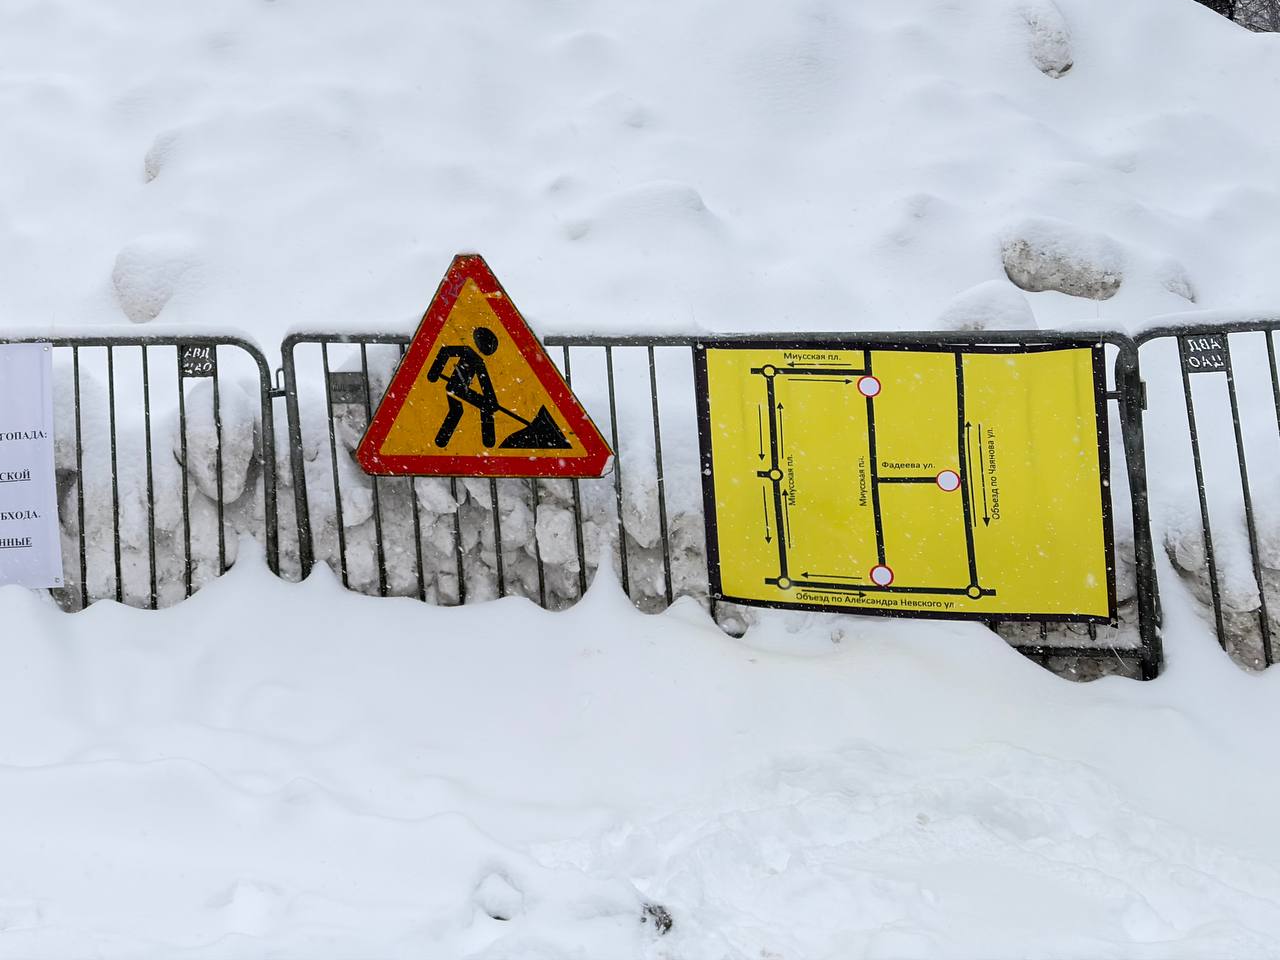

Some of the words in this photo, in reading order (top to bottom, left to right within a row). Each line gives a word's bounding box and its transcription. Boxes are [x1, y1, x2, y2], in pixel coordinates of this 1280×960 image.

[183, 347, 210, 359] АВД
[783, 352, 826, 361] Миусская
[987, 427, 995, 439] ул.
[786, 454, 795, 467] пл.
[987, 440, 997, 475] Чаянова
[881, 461, 921, 470] Фадеева
[787, 467, 796, 506] Миусская
[858, 469, 868, 507] Миусская
[990, 476, 998, 487] по
[991, 488, 1001, 520] Объезд
[795, 592, 830, 602] Объезд
[844, 595, 898, 607] Александра
[899, 599, 943, 609] Невского
